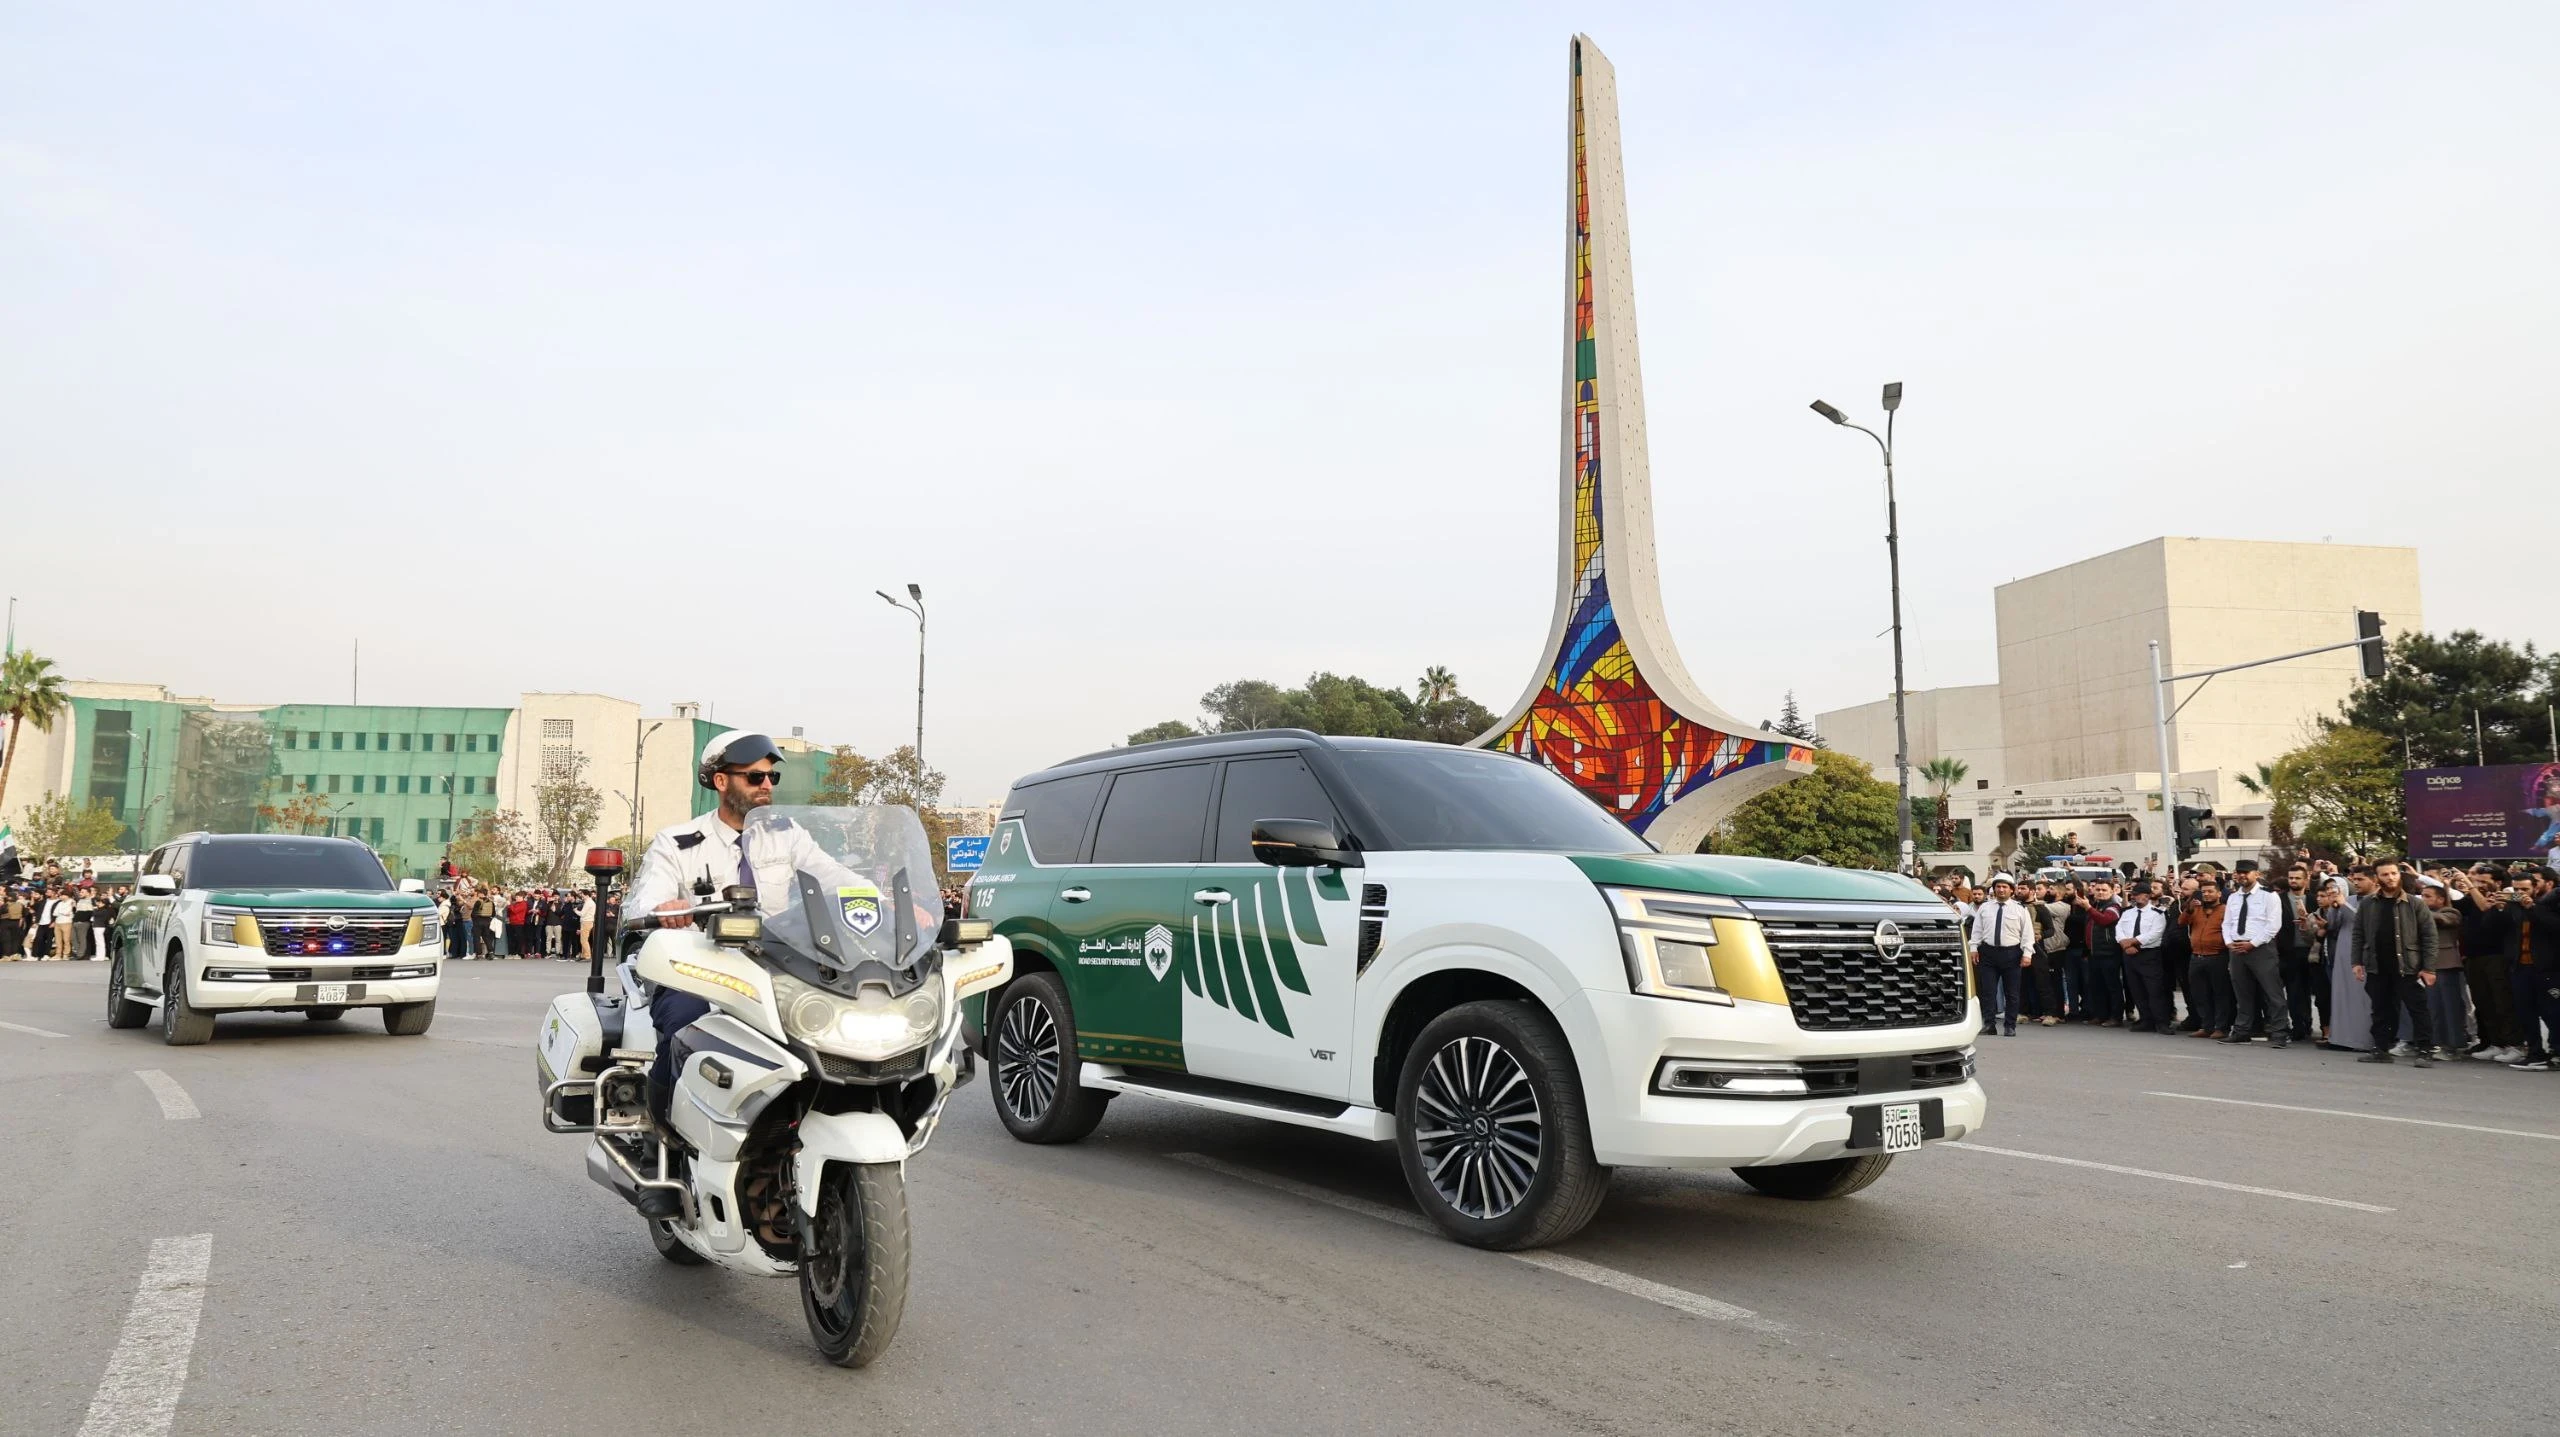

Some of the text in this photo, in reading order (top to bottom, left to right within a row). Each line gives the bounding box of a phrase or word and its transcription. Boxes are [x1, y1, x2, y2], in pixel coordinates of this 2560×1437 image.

[976, 888, 996, 908] 115
[1105, 935, 1128, 953] أمن
[1128, 938, 1142, 953] إدارة
[1091, 957, 1112, 966] SECURITY
[1112, 958, 1142, 966] DEPARTMENT
[319, 991, 345, 1002] 4087
[1885, 1109, 1900, 1123] 530
[1886, 1122, 1919, 1149] 2058
